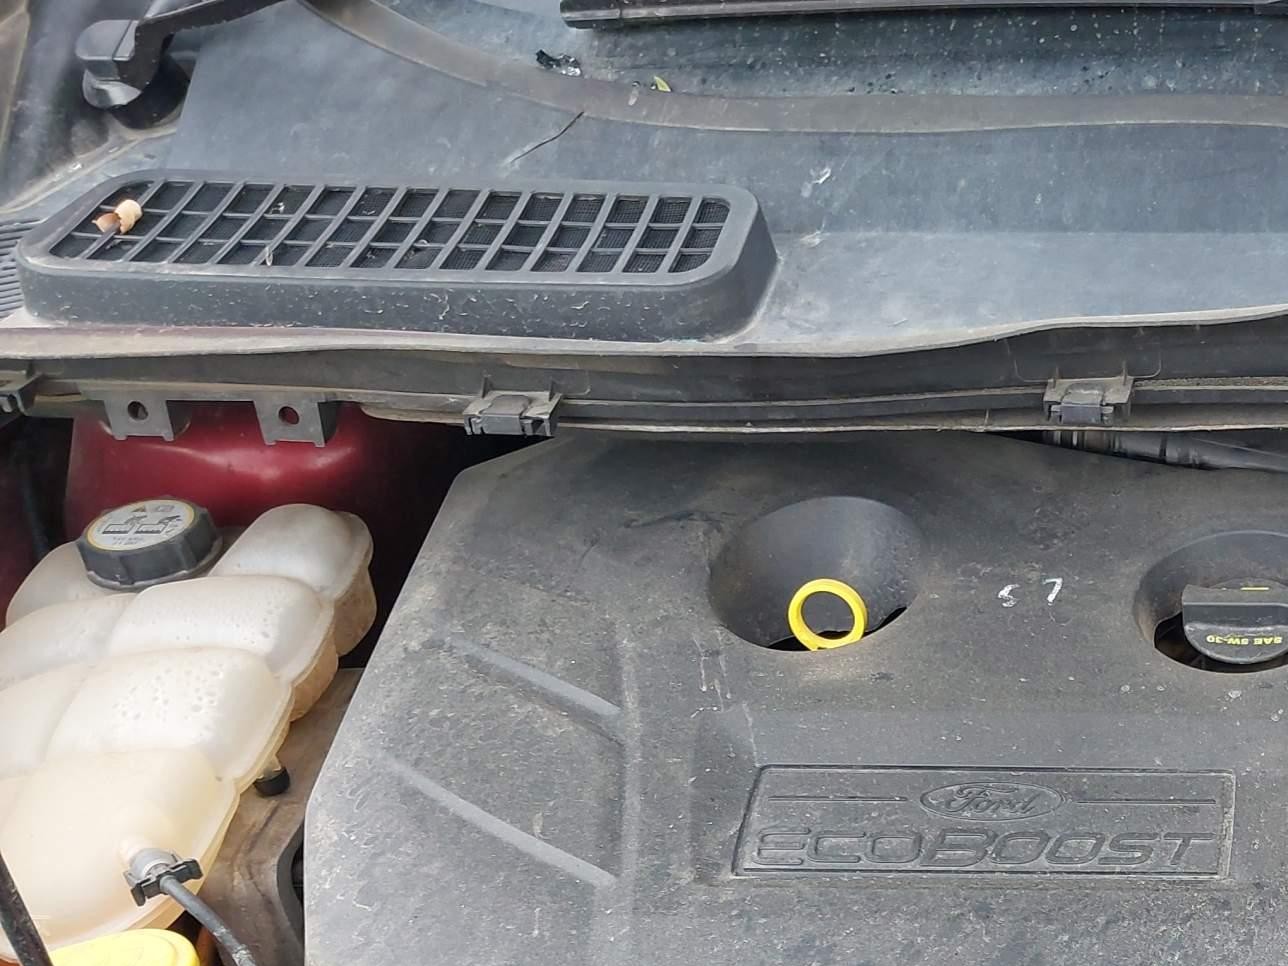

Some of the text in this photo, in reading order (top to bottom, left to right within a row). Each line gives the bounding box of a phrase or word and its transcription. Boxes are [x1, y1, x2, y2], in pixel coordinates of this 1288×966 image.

[1206, 634, 1283, 645] SAE 5W-30
[944, 785, 1036, 816] Ford
[752, 826, 1217, 868] ECOBOOST
